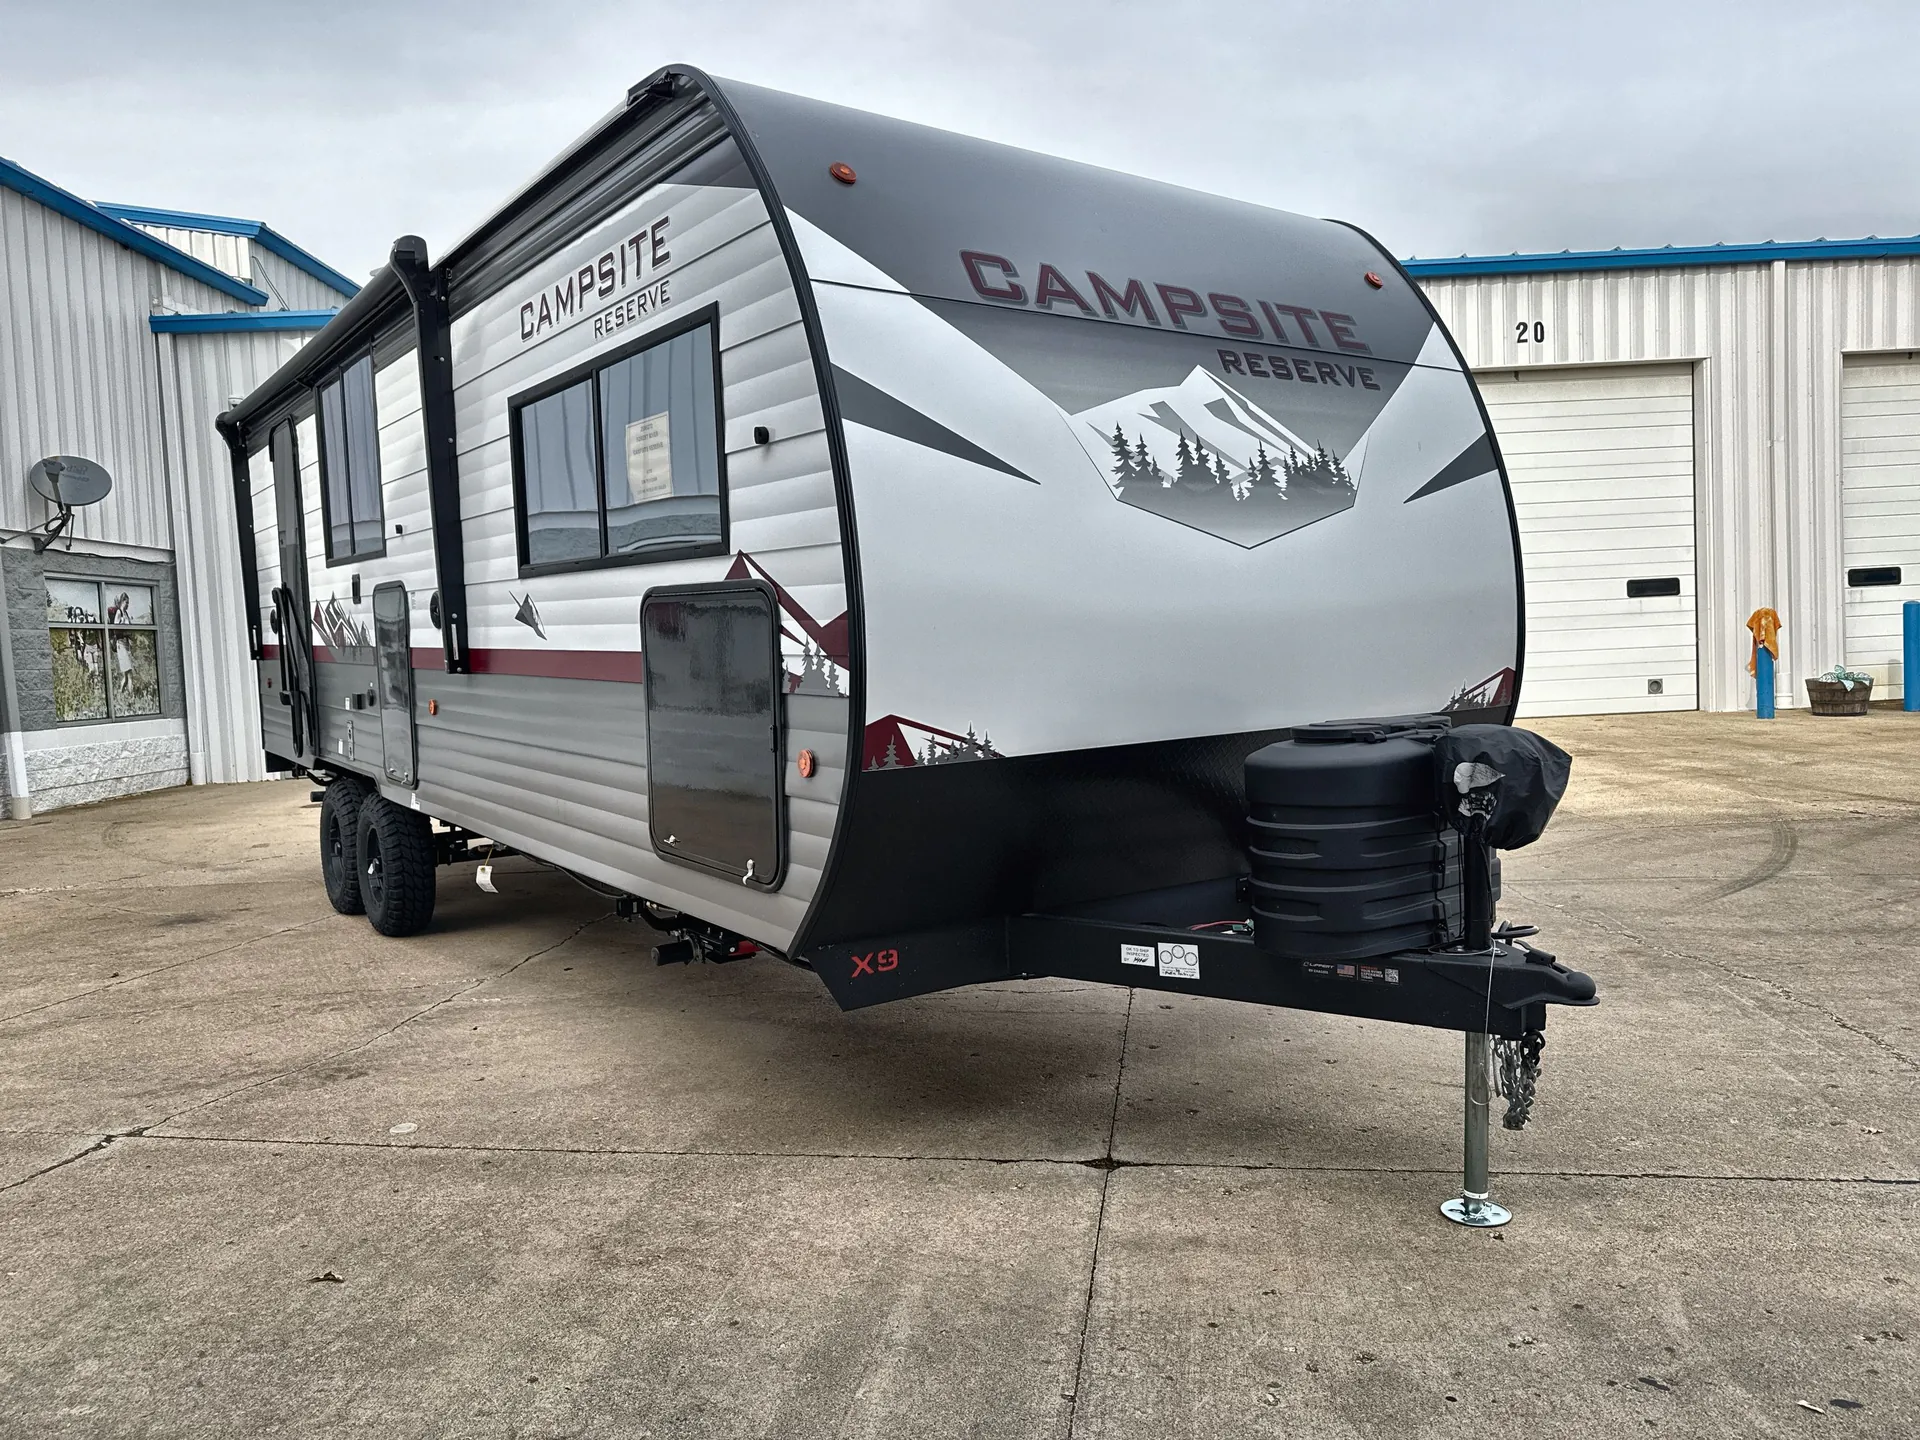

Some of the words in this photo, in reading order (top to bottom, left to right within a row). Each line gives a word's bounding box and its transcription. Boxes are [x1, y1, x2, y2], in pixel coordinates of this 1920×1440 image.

[520, 215, 671, 342] CAMPSITE
[959, 248, 1372, 352] CAMPSITE
[593, 280, 671, 339] RESERVE
[1516, 321, 1545, 344] 20
[1217, 349, 1381, 391] RESERVE
[851, 949, 898, 978] X9
